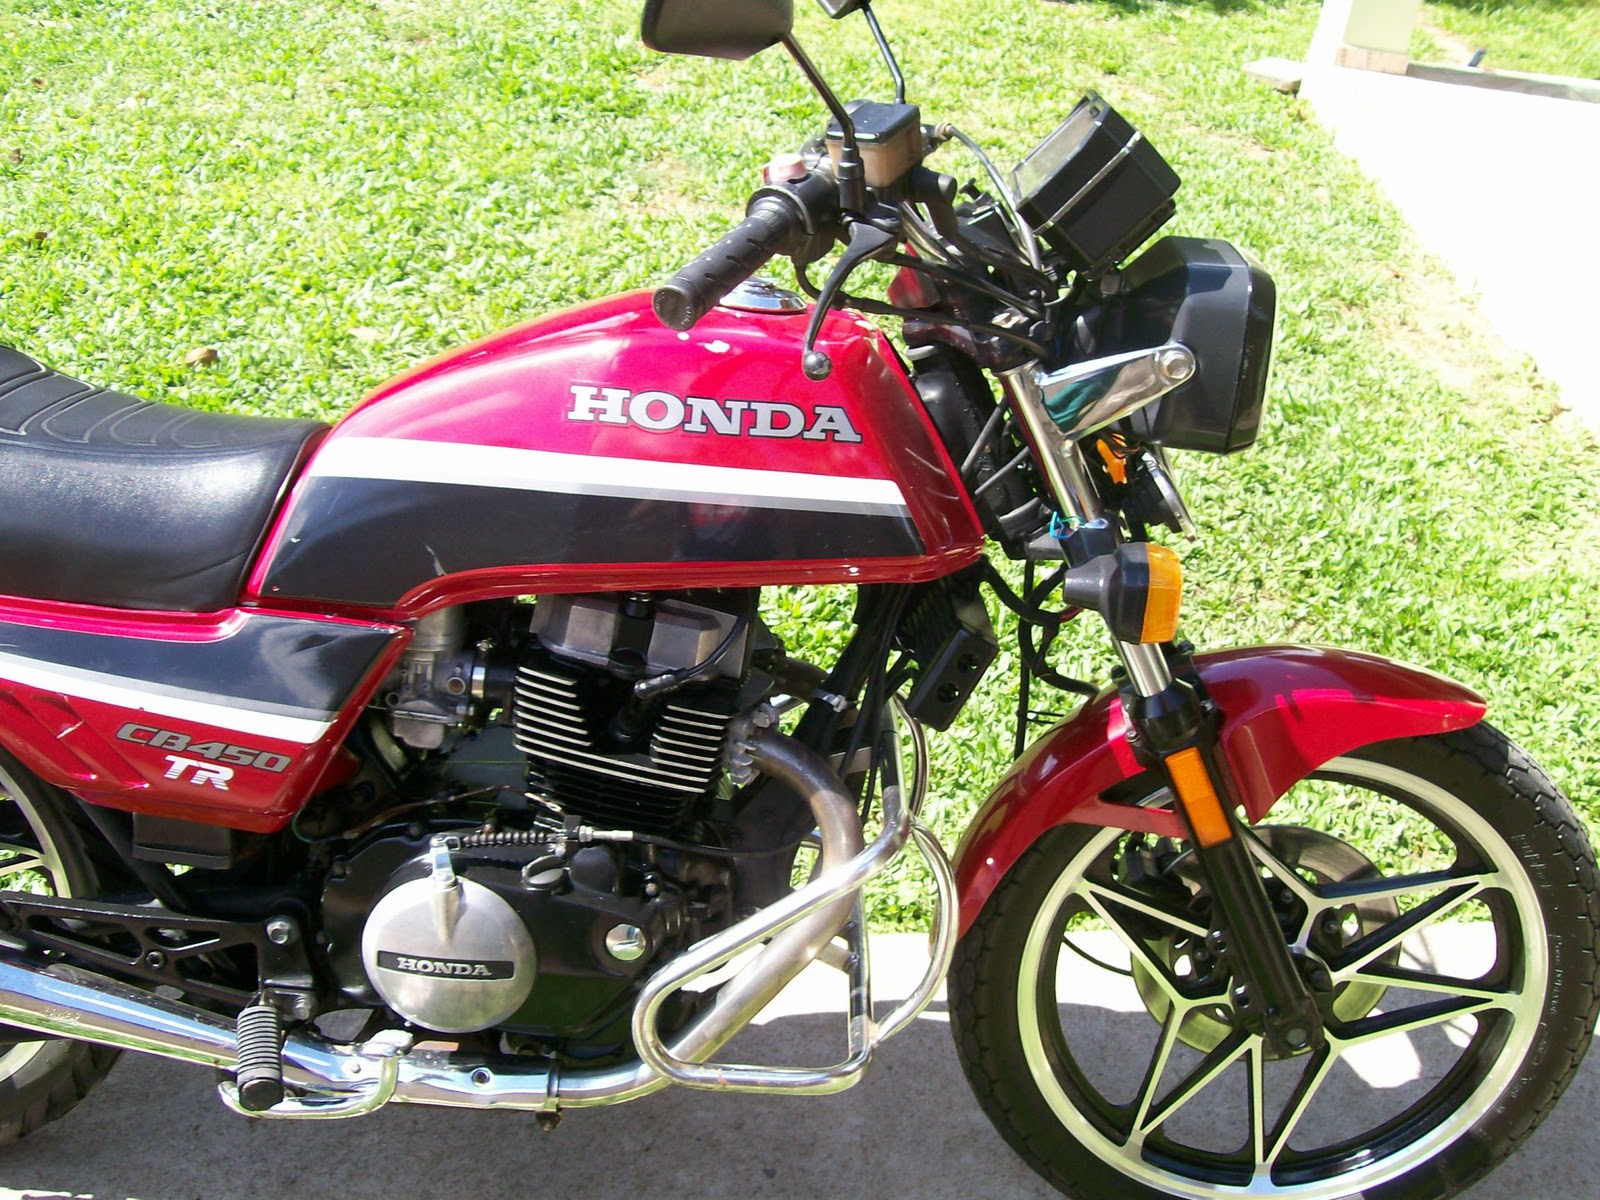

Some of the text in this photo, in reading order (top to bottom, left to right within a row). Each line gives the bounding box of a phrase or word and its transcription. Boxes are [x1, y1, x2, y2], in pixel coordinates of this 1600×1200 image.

[567, 384, 863, 444] HONDA
[115, 722, 292, 773] CB450
[163, 754, 235, 791] TR
[396, 956, 493, 977] HONDA
